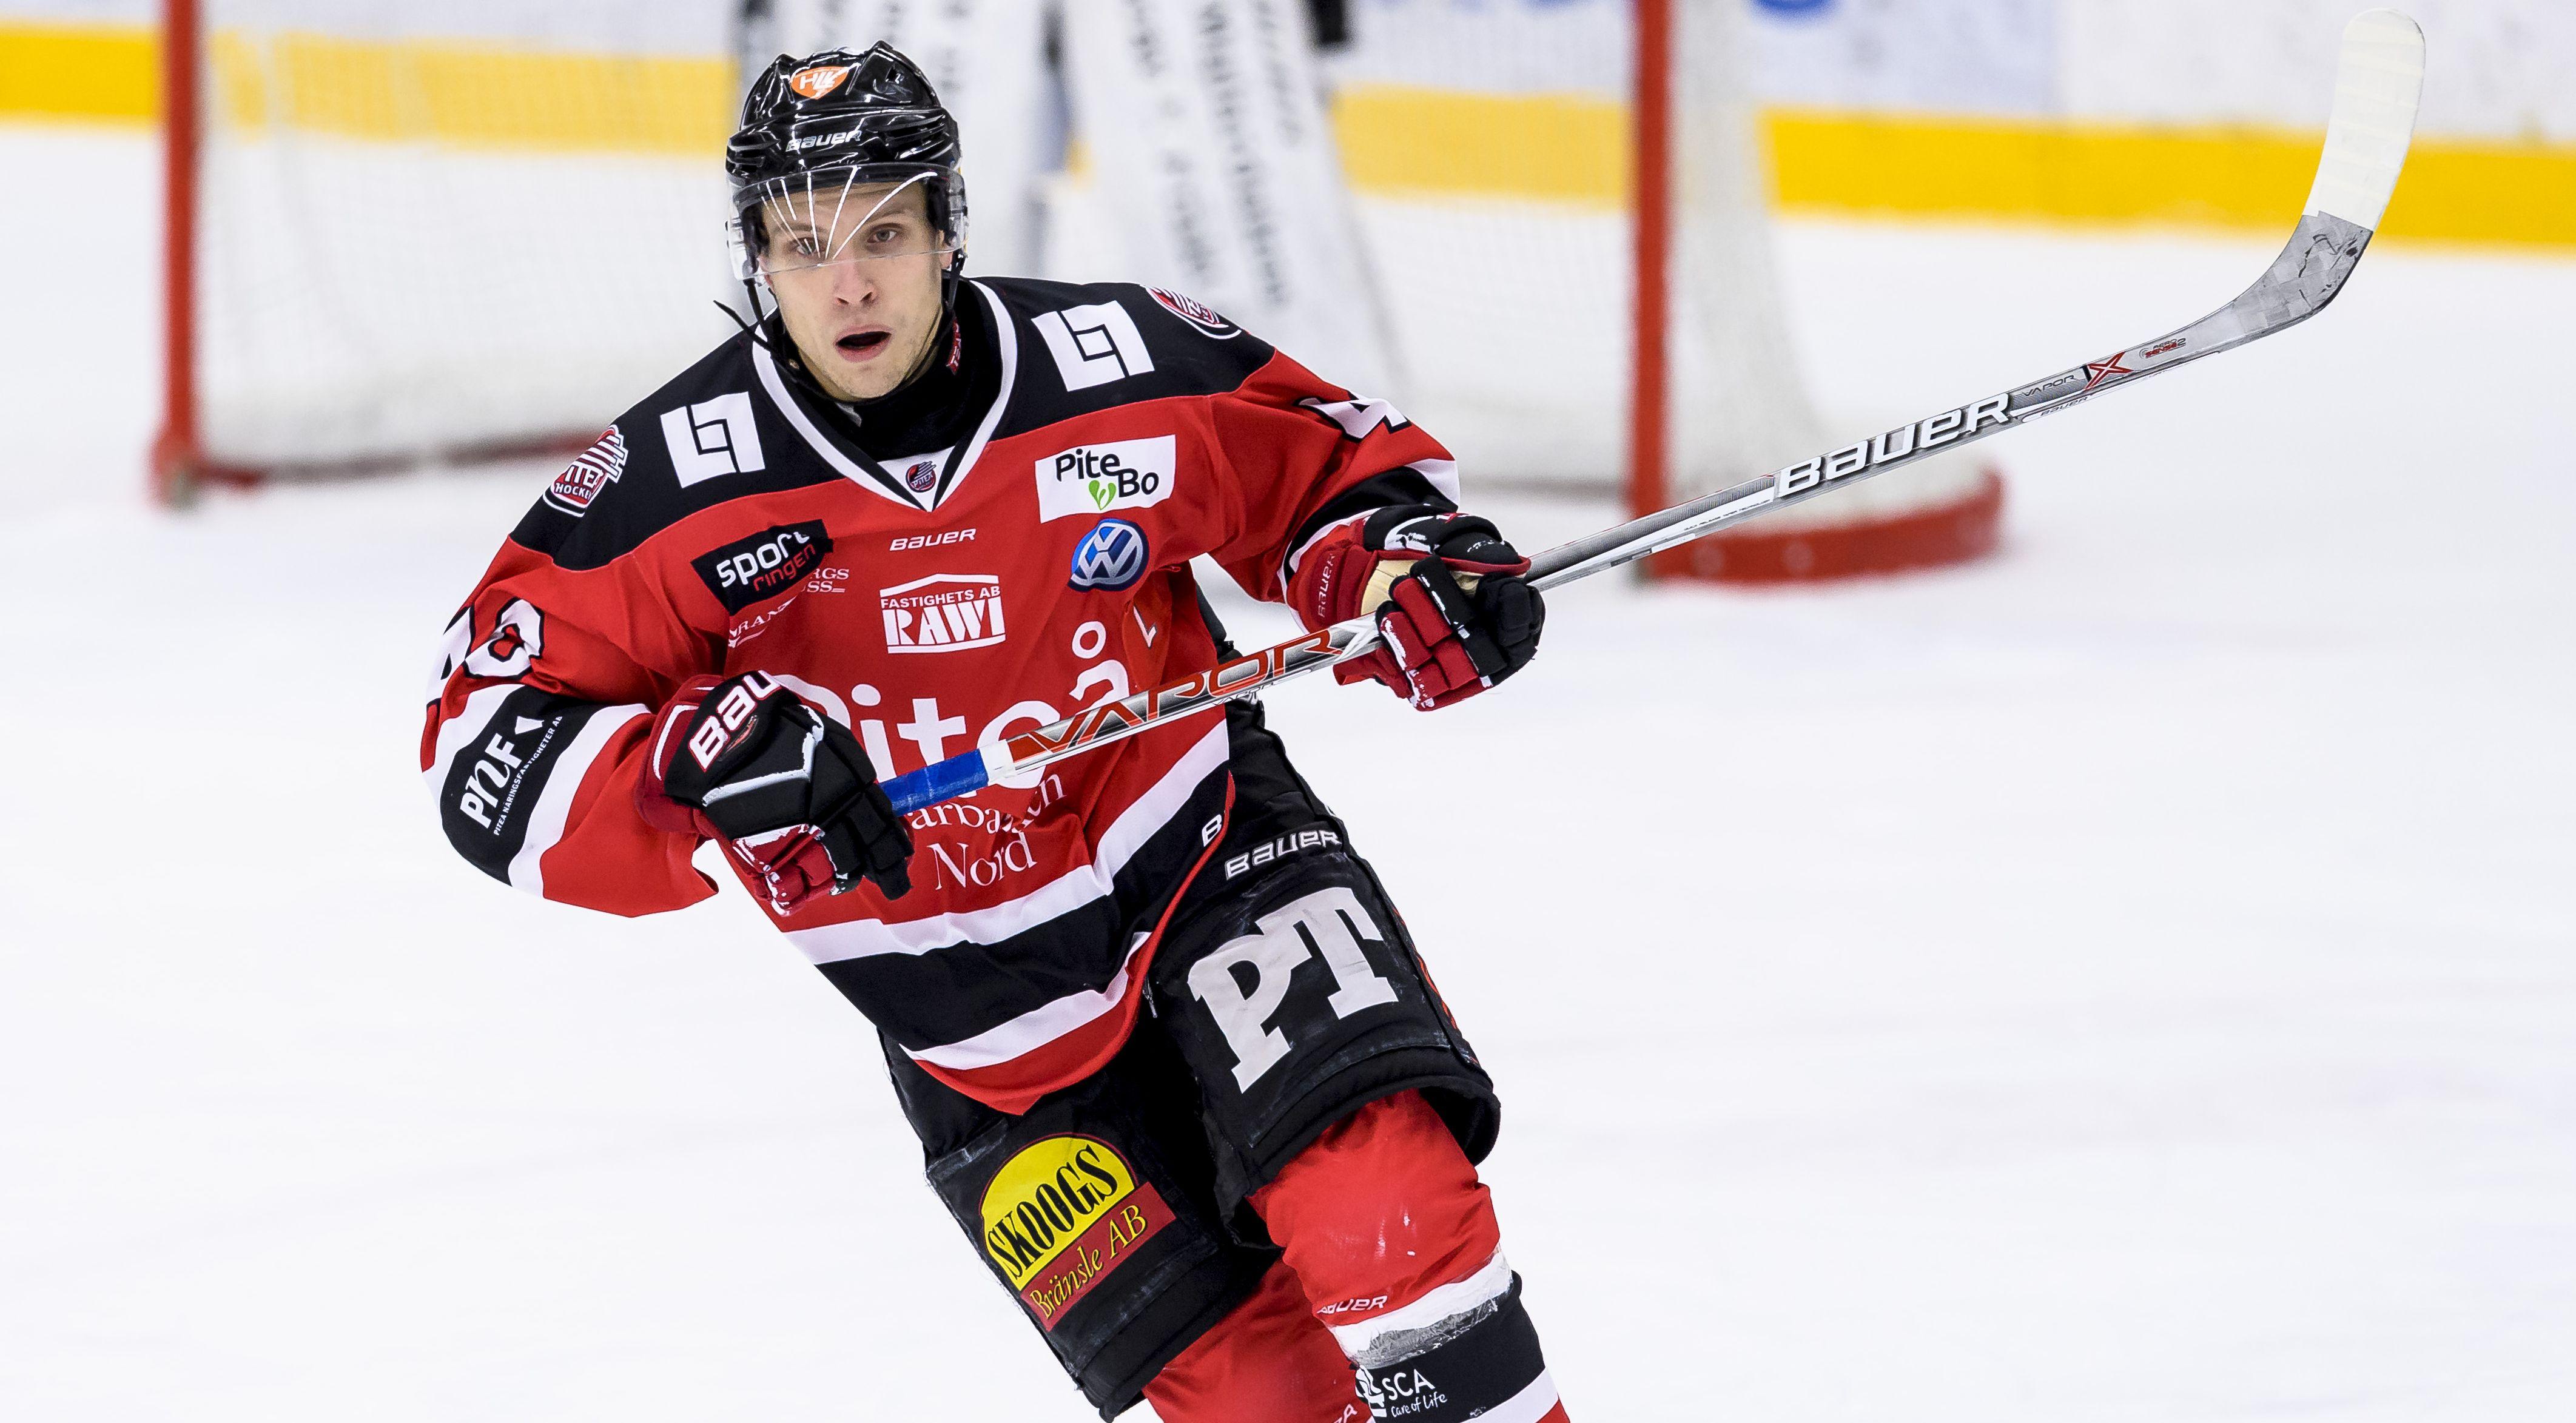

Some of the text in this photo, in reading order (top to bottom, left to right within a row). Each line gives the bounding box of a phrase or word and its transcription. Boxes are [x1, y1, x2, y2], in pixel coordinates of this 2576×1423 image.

[785, 130, 862, 152] BAUER
[2022, 374, 2080, 397] VAPOR
[1055, 448, 1120, 482] Pite
[1777, 392, 2009, 498] BAUER
[1117, 468, 1160, 498] Bo
[716, 531, 810, 588] sport
[889, 528, 977, 551] BAUER
[752, 543, 816, 592] ringen
[880, 585, 1001, 609] FASTIGHETS AB
[882, 596, 1006, 646] RAWI
[1026, 627, 1343, 754] VAPOR
[926, 831, 1038, 890] Nord
[1225, 829, 1342, 881] BAUER
[1187, 886, 1399, 1094] PT
[987, 1143, 1118, 1280] SKOOGS
[1029, 1204, 1148, 1319] Bränsle AB
[1382, 1368, 1436, 1401] SCA
[1411, 1396, 1422, 1413] of
